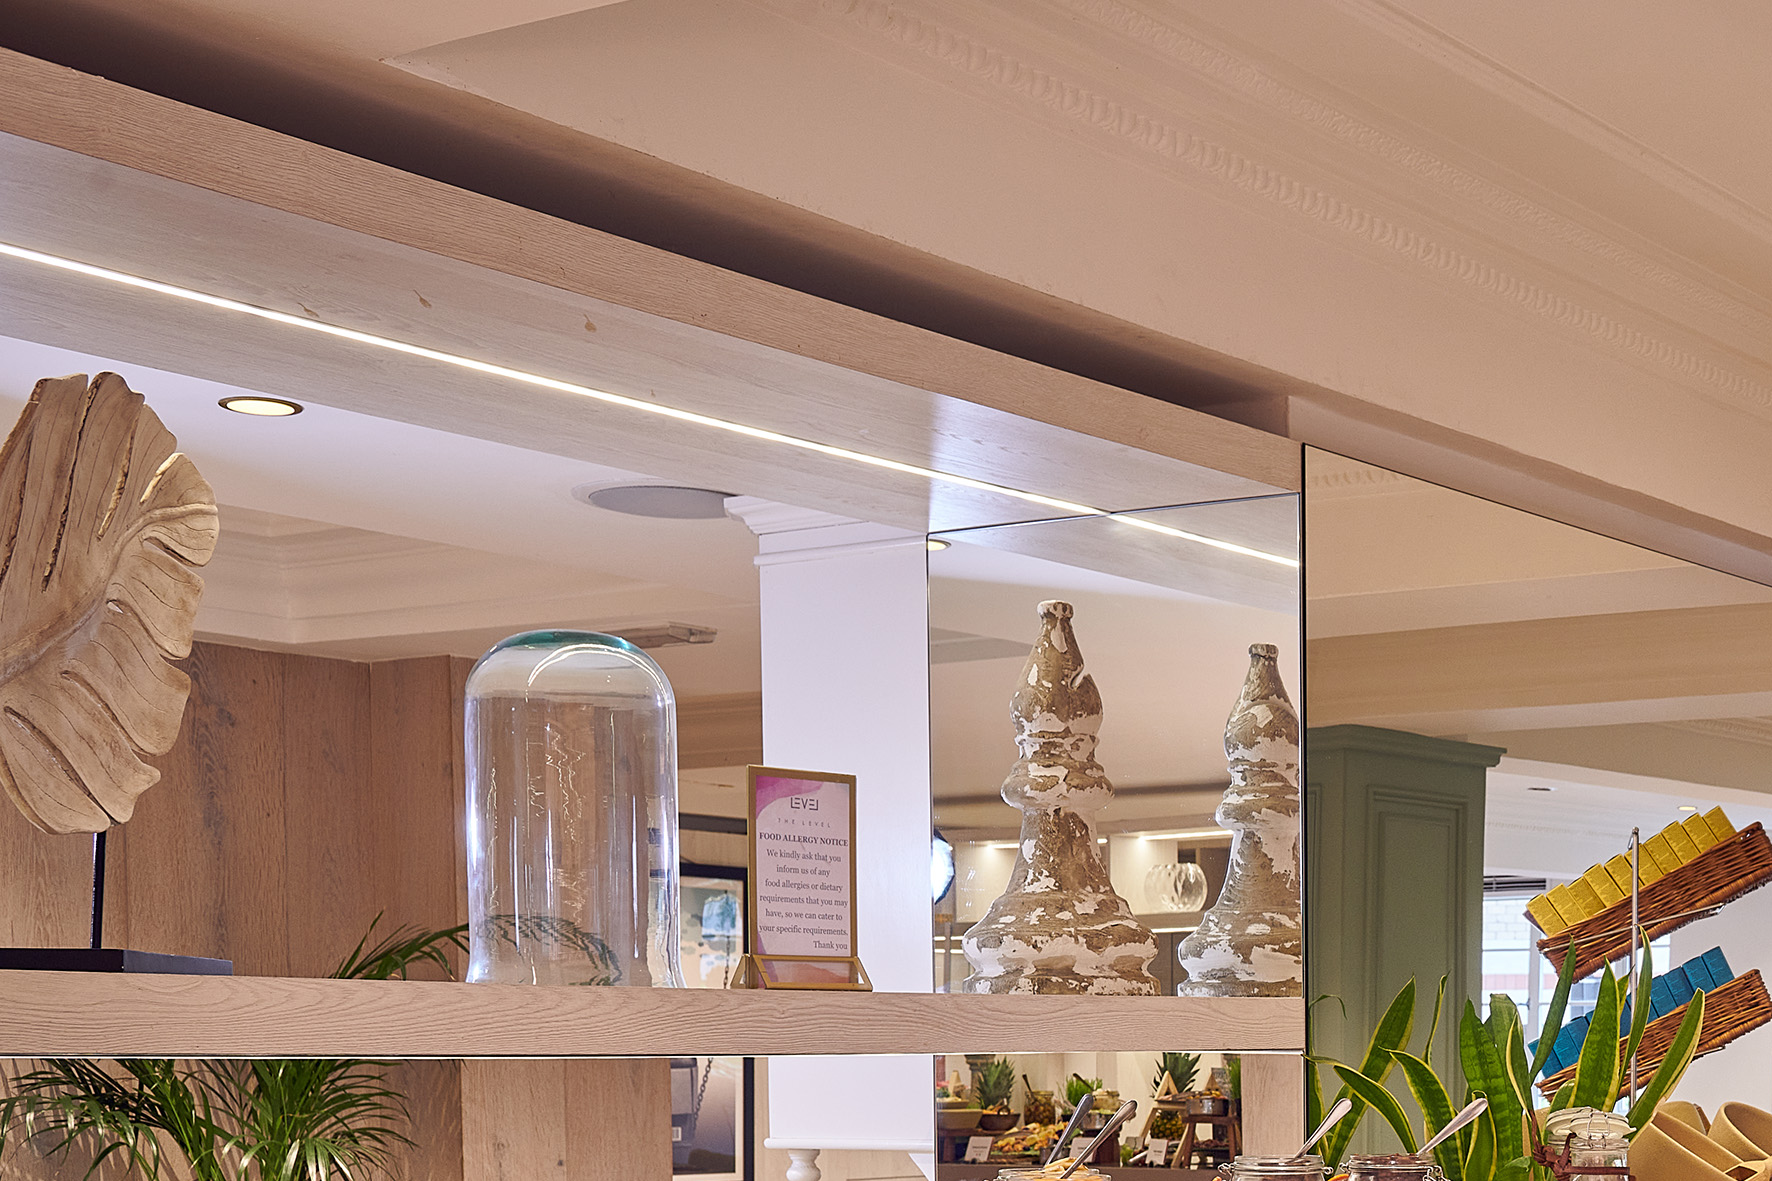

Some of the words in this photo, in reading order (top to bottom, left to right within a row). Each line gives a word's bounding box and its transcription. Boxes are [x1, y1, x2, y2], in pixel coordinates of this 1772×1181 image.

[790, 797, 819, 811] LEVEL
[777, 817, 795, 825] THE
[801, 820, 831, 828] LEVEL
[759, 832, 782, 841] FOOD
[782, 834, 819, 844] ALLERGY
[819, 837, 849, 847] NOTICE
[766, 849, 778, 857] We
[779, 849, 801, 861] kindly
[801, 851, 814, 860] ask
[814, 852, 828, 861] that
[828, 855, 842, 863] you
[776, 864, 800, 874] inform
[809, 867, 818, 875] of
[765, 878, 781, 887] food
[781, 879, 810, 891] allergies
[819, 882, 844, 893] dietary
[759, 893, 805, 904] requirements
[805, 896, 820, 905] that
[820, 899, 833, 907] you
[834, 899, 849, 908] may
[765, 908, 784, 918] have,
[804, 912, 817, 920] can
[817, 913, 834, 921] cater
[758, 924, 775, 933] your
[775, 924, 801, 935] specific
[802, 926, 849, 936] requirements.
[813, 940, 835, 950] Thank
[835, 943, 848, 951] you
